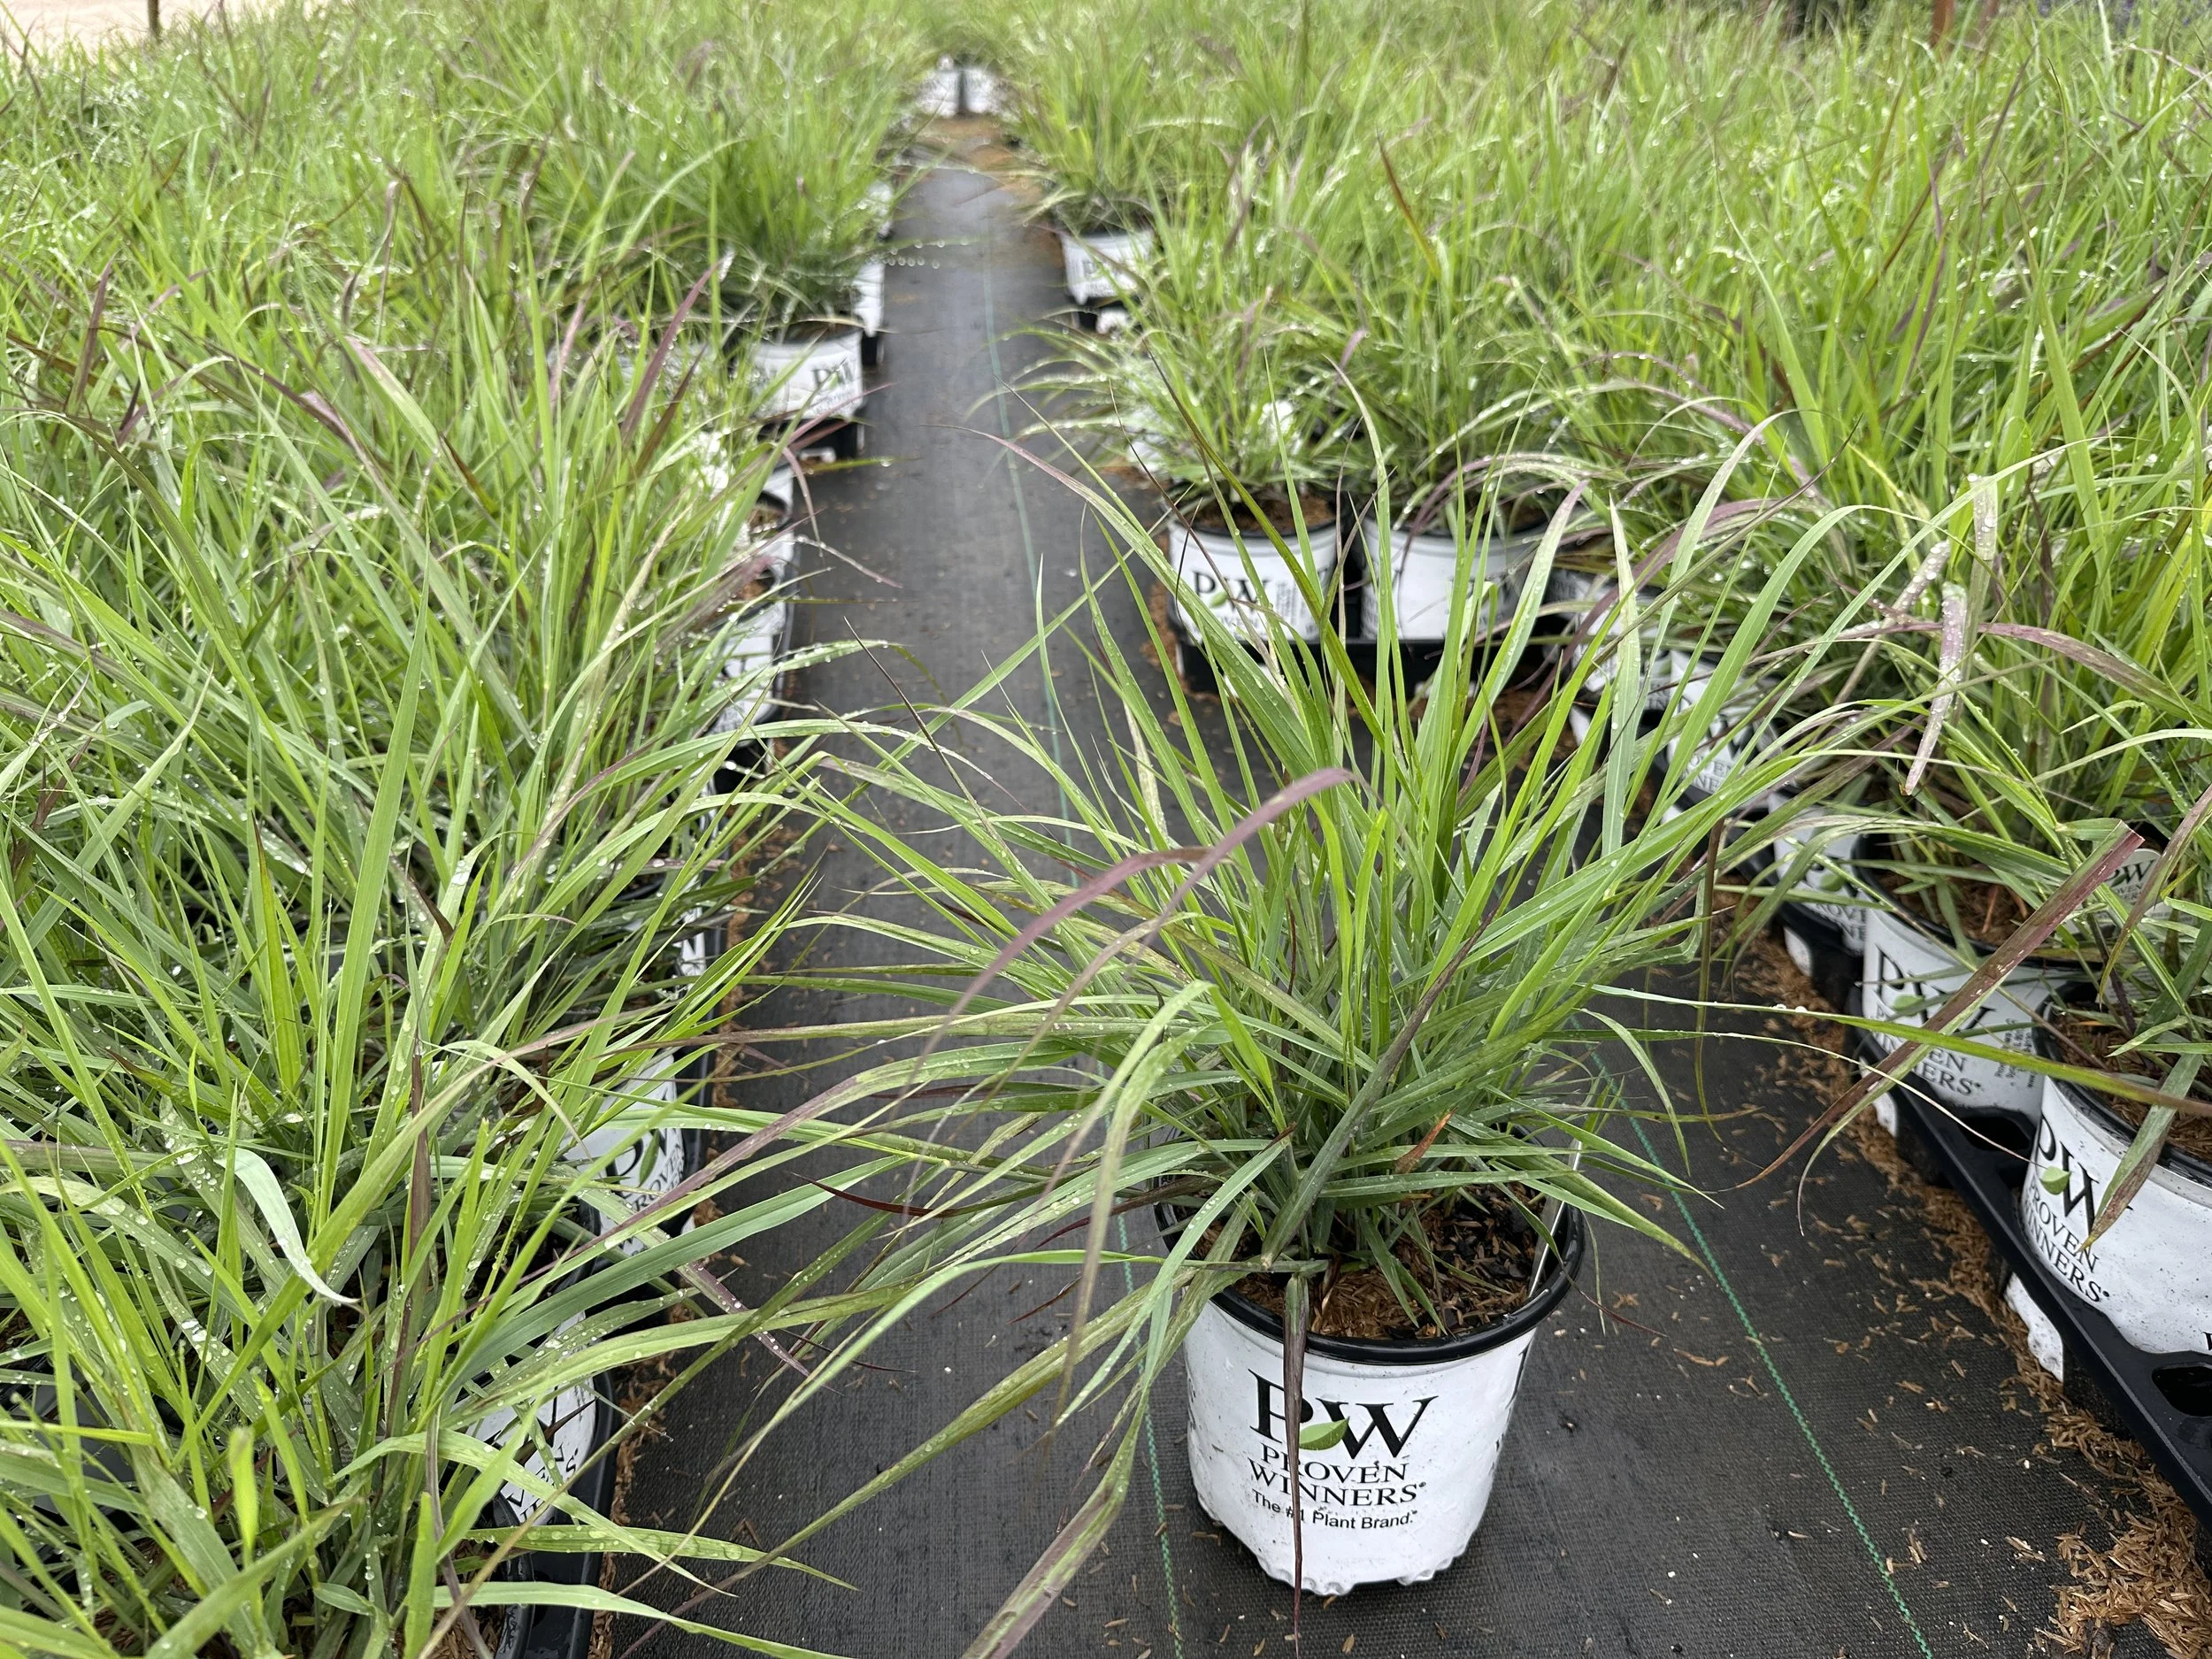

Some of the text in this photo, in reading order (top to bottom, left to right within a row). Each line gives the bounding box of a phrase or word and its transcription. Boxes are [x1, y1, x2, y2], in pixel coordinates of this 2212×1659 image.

[1248, 1368, 1440, 1459] PW
[1261, 1442, 1409, 1484] PROVEN
[1252, 1488, 1281, 1513] The
[1313, 1510, 1356, 1529] Plant
